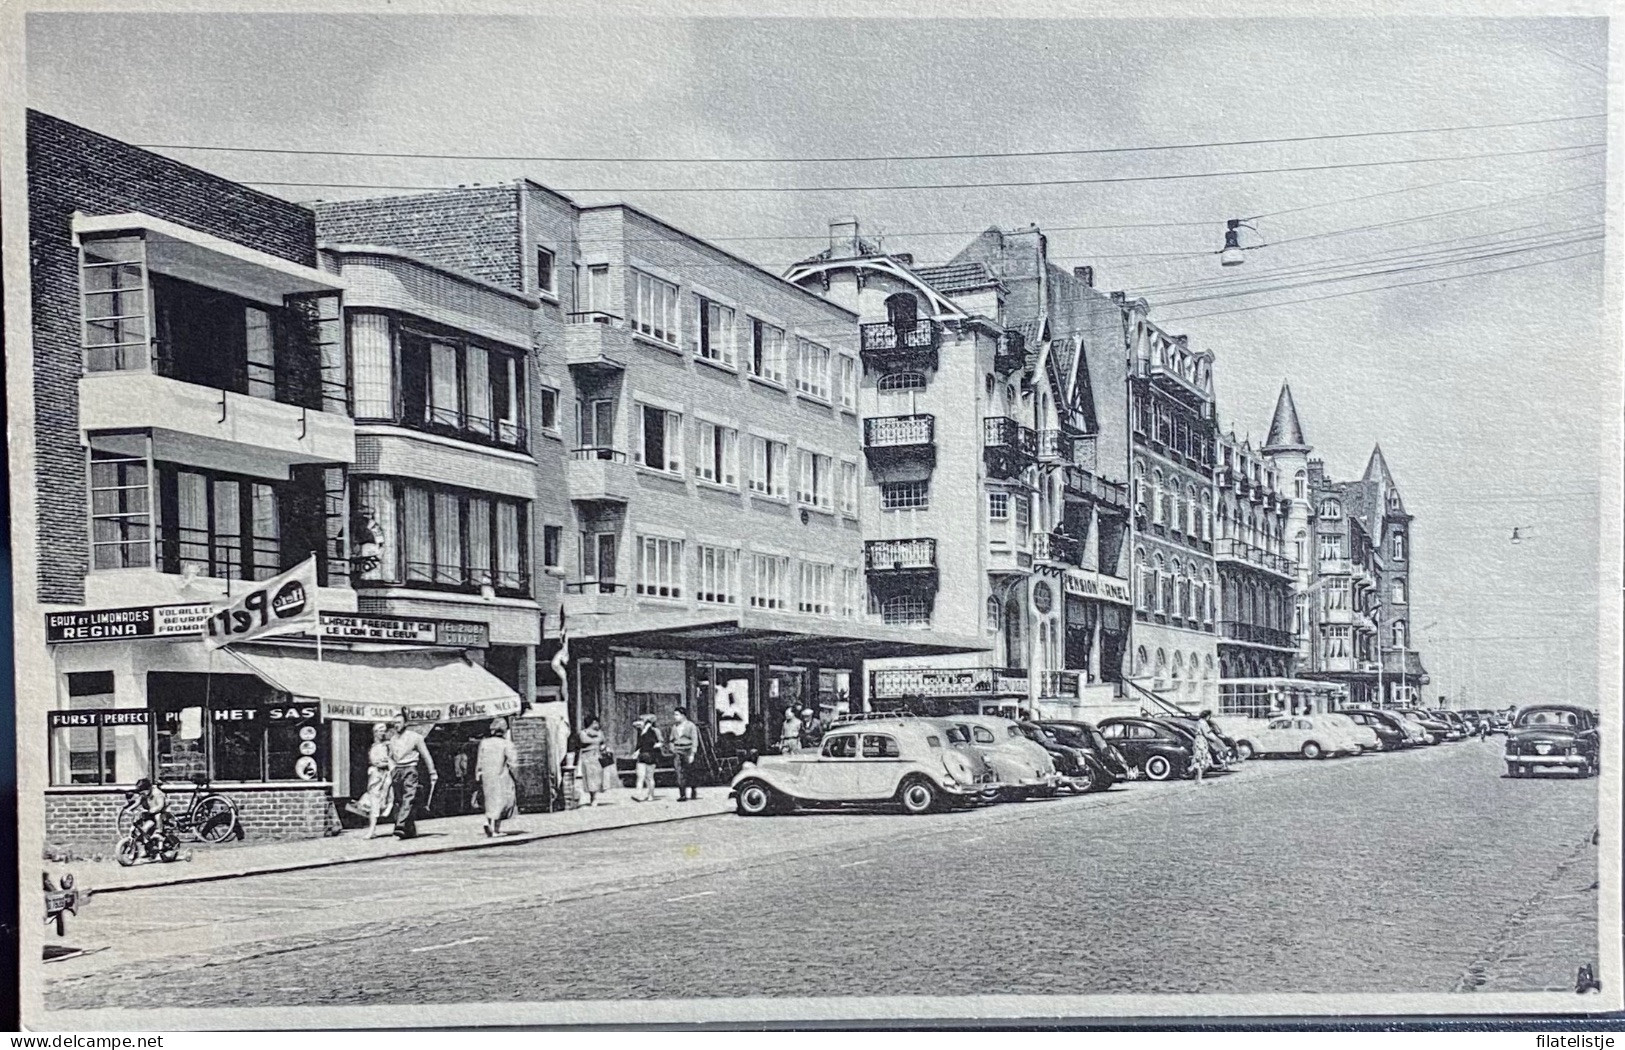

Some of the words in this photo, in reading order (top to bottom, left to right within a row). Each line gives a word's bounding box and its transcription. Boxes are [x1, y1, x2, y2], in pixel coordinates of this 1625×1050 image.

[1064, 572, 1098, 595] PENSION
[50, 615, 77, 627] EAUX
[91, 610, 150, 625] LIMONADES
[63, 623, 138, 639] REGINA
[326, 626, 340, 635] LE
[343, 627, 366, 636] LION
[370, 629, 382, 637] DE
[53, 713, 97, 725] FURST
[104, 711, 149, 724] PERFECT
[215, 709, 257, 721] HET
[269, 707, 317, 719] SAS
